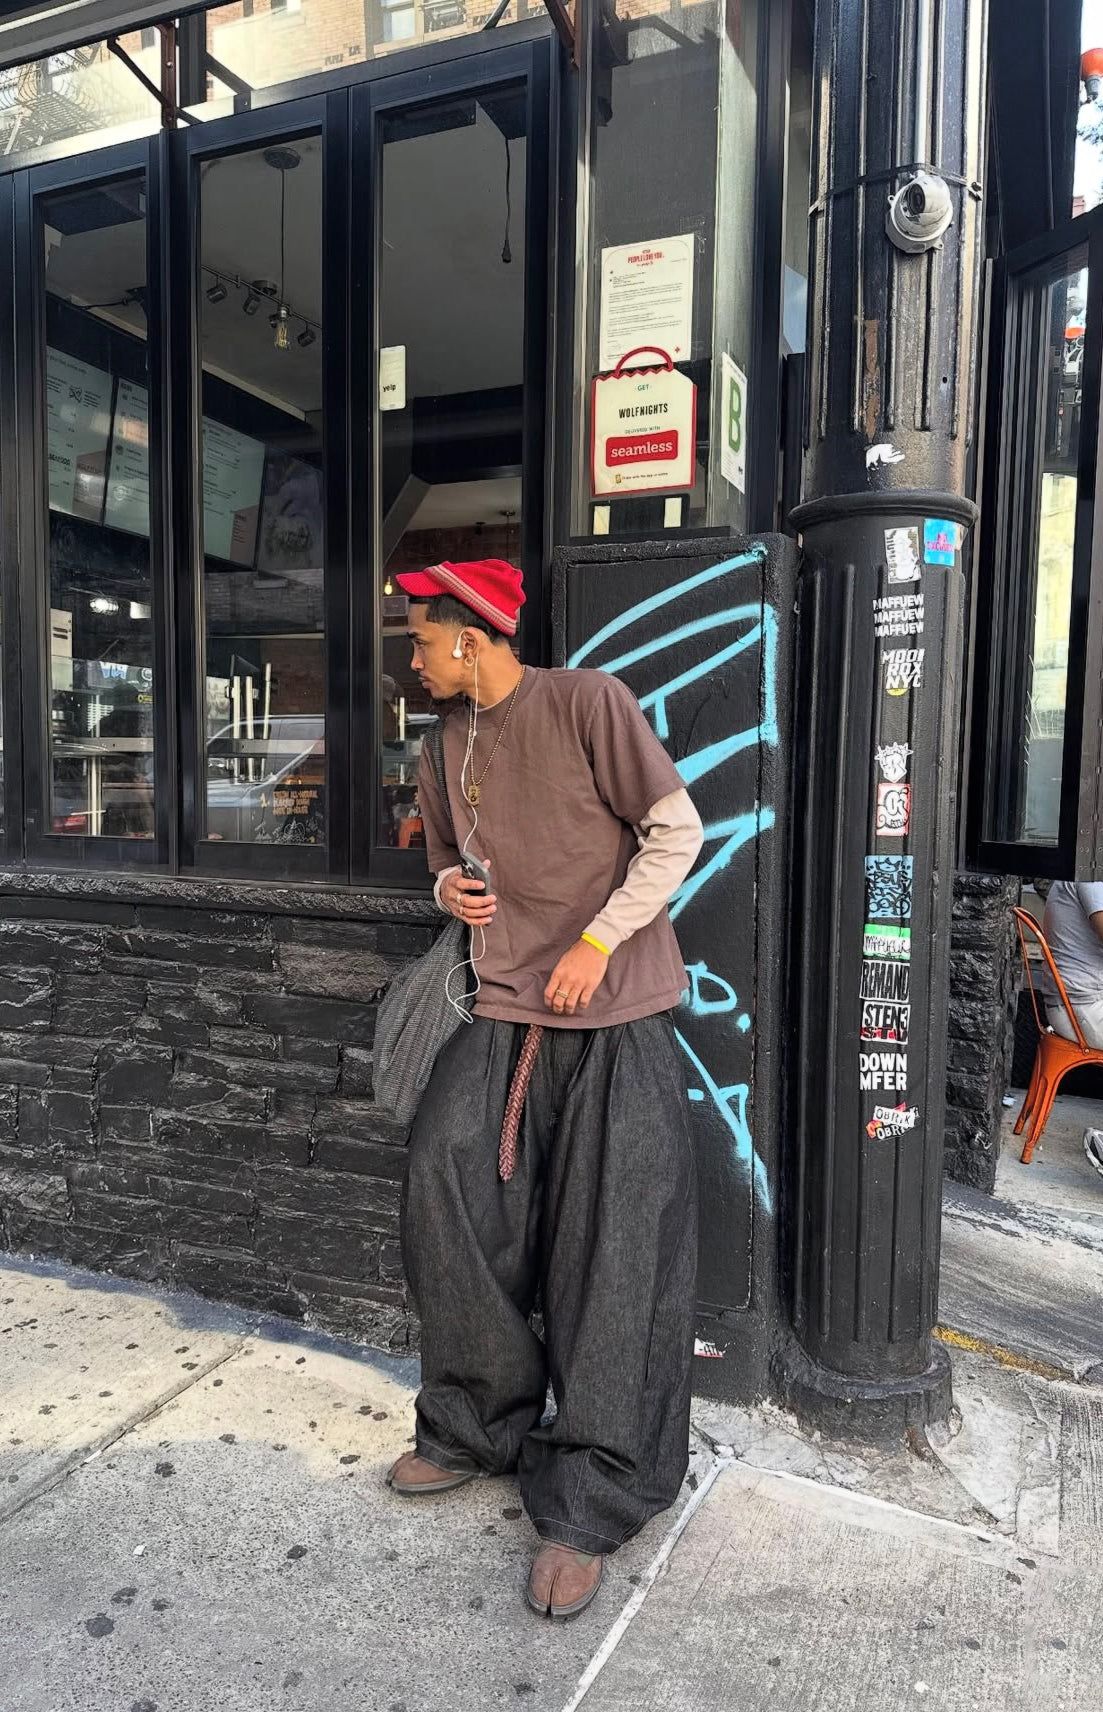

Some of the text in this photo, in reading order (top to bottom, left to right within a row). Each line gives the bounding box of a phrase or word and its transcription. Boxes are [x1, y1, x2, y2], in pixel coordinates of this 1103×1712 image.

[382, 384, 396, 392] yelp
[618, 403, 668, 419] WOLFNIGHTS
[728, 377, 741, 453] B
[611, 441, 673, 458] seamless
[886, 675, 922, 689] NYC
[859, 1053, 908, 1072] DOWN
[859, 1071, 907, 1091] MFER
